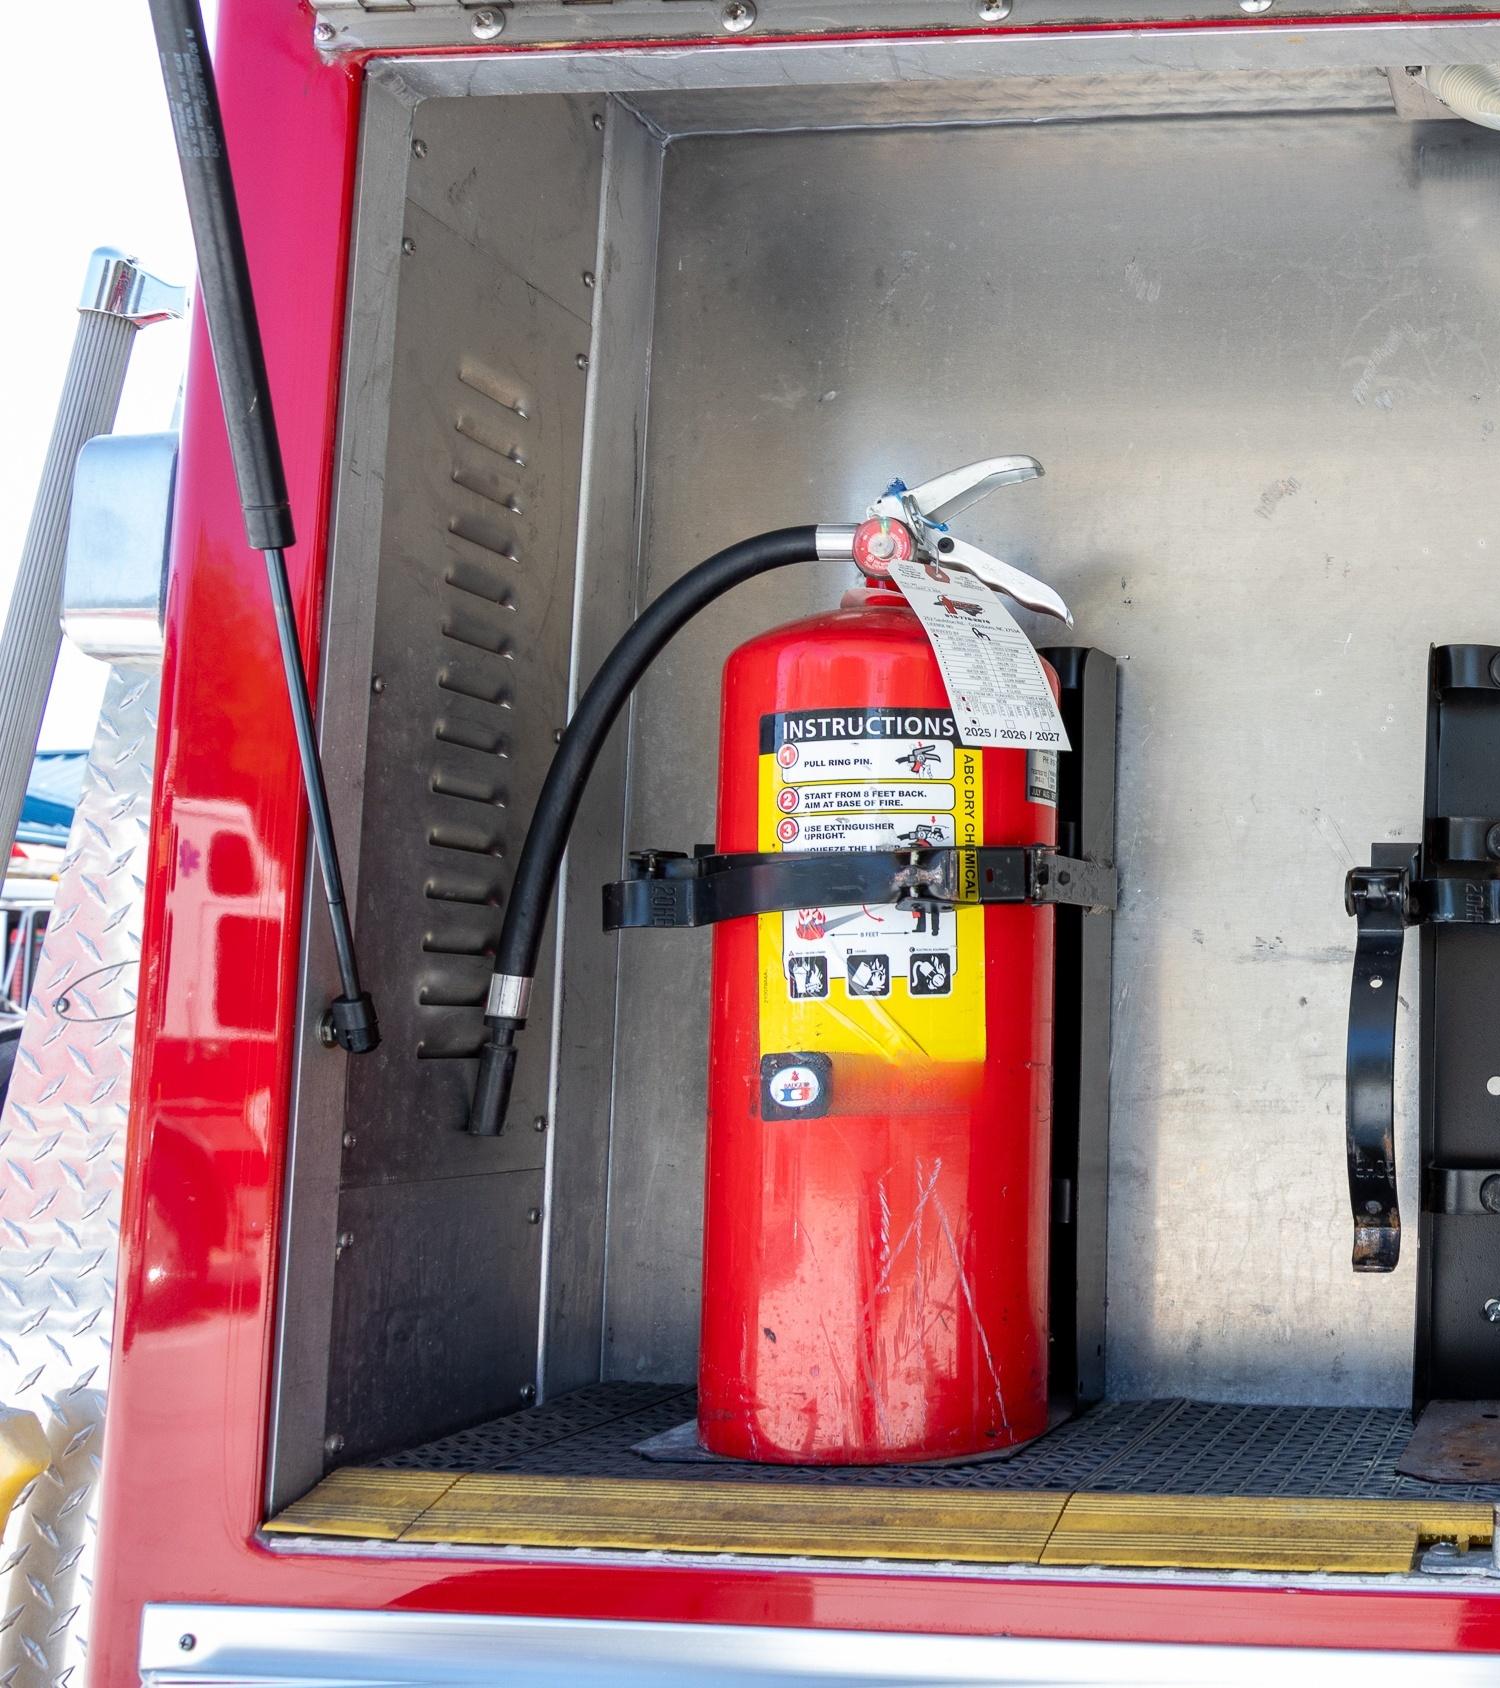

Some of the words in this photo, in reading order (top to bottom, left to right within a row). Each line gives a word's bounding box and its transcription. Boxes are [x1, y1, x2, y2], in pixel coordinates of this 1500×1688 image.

[783, 716, 954, 740] INSTRUCTIONS
[964, 726, 992, 738] 2025
[1000, 729, 1027, 740] 2026
[1035, 731, 1060, 742] 2027
[804, 760, 826, 768] PULL
[829, 759, 851, 767] RING
[853, 758, 873, 766] PIN.
[963, 754, 975, 785] ABC
[781, 793, 793, 807] 2
[804, 791, 833, 800] START
[835, 791, 861, 799] FROM
[863, 790, 870, 798] 8
[872, 790, 896, 798] FEET
[899, 790, 927, 798] BACK.
[879, 799, 903, 807] FIRE.
[964, 790, 975, 819] DRY
[782, 823, 793, 837] 3
[804, 825, 822, 833] USE
[824, 823, 894, 832] EXTINGUISHER
[804, 832, 846, 841] UPRIGHT.
[964, 823, 976, 899] CHEMICAL
